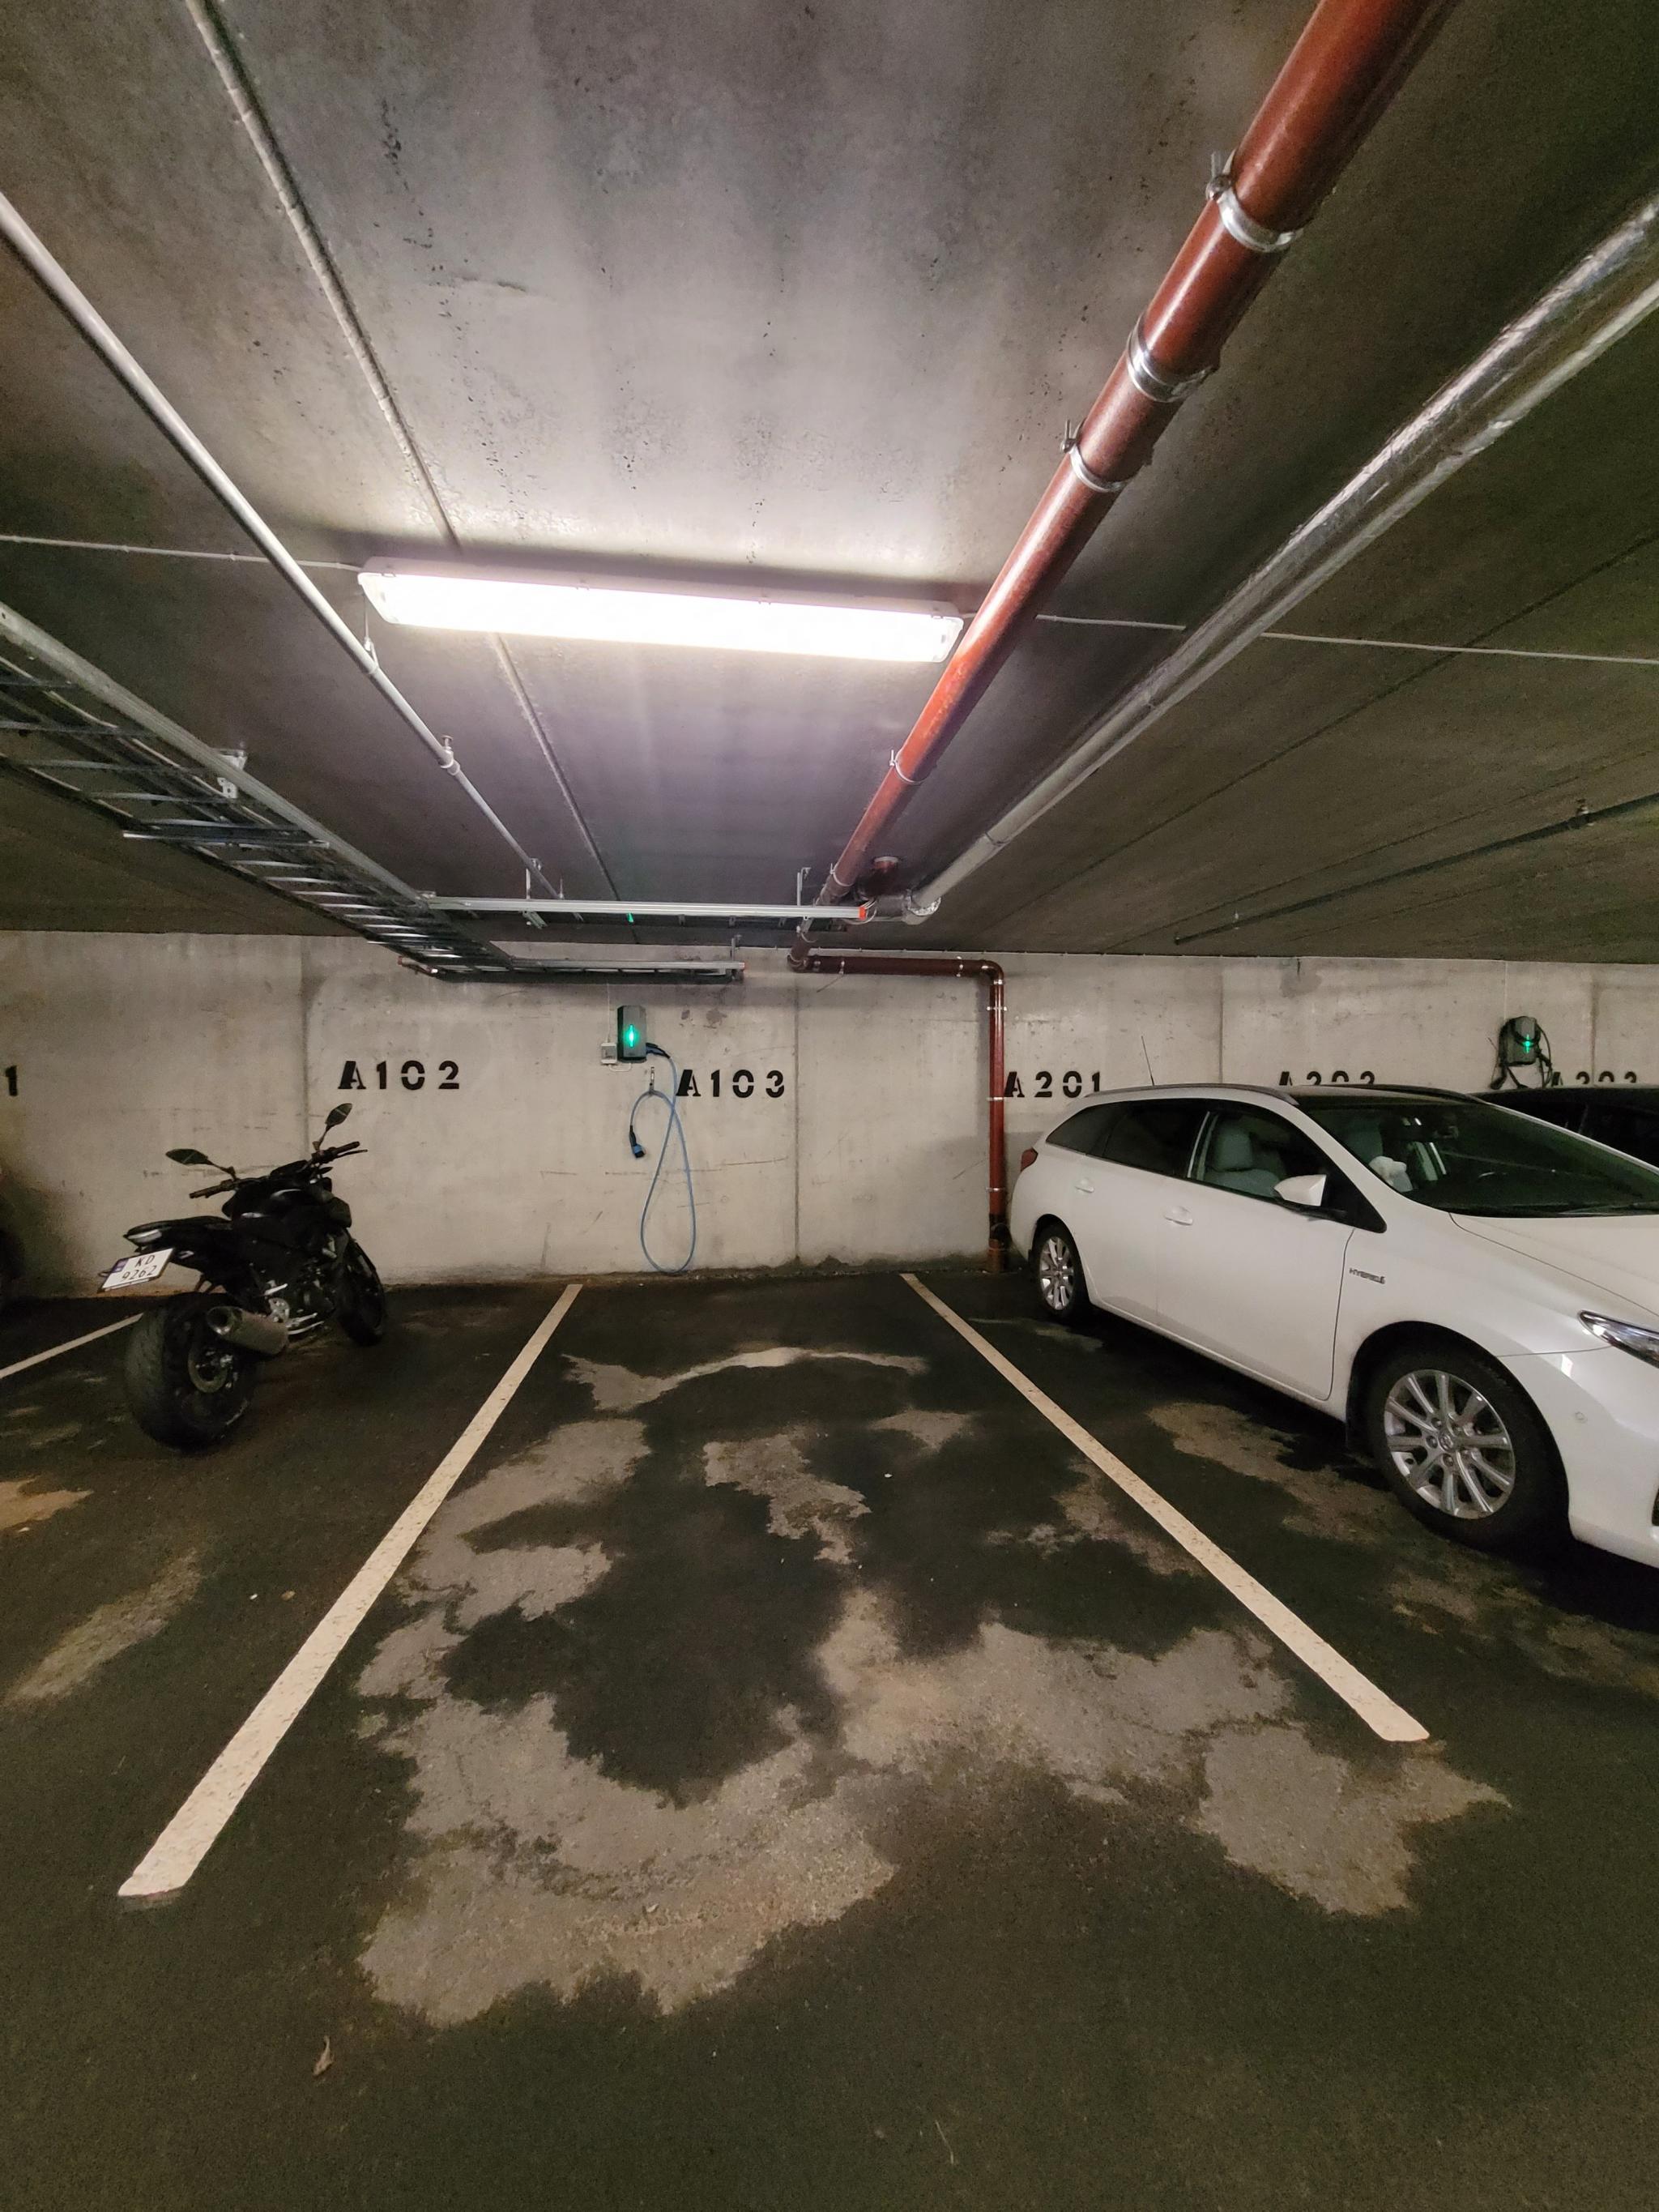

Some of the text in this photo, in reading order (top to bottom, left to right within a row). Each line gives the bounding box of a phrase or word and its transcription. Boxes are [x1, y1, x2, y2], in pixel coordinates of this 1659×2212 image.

[5, 1065, 18, 1096] 1
[337, 1060, 460, 1091] A102
[676, 1069, 785, 1099] A103
[1004, 1070, 1101, 1098] A201
[122, 1265, 158, 1280] 9262
[134, 1254, 156, 1268] KD
